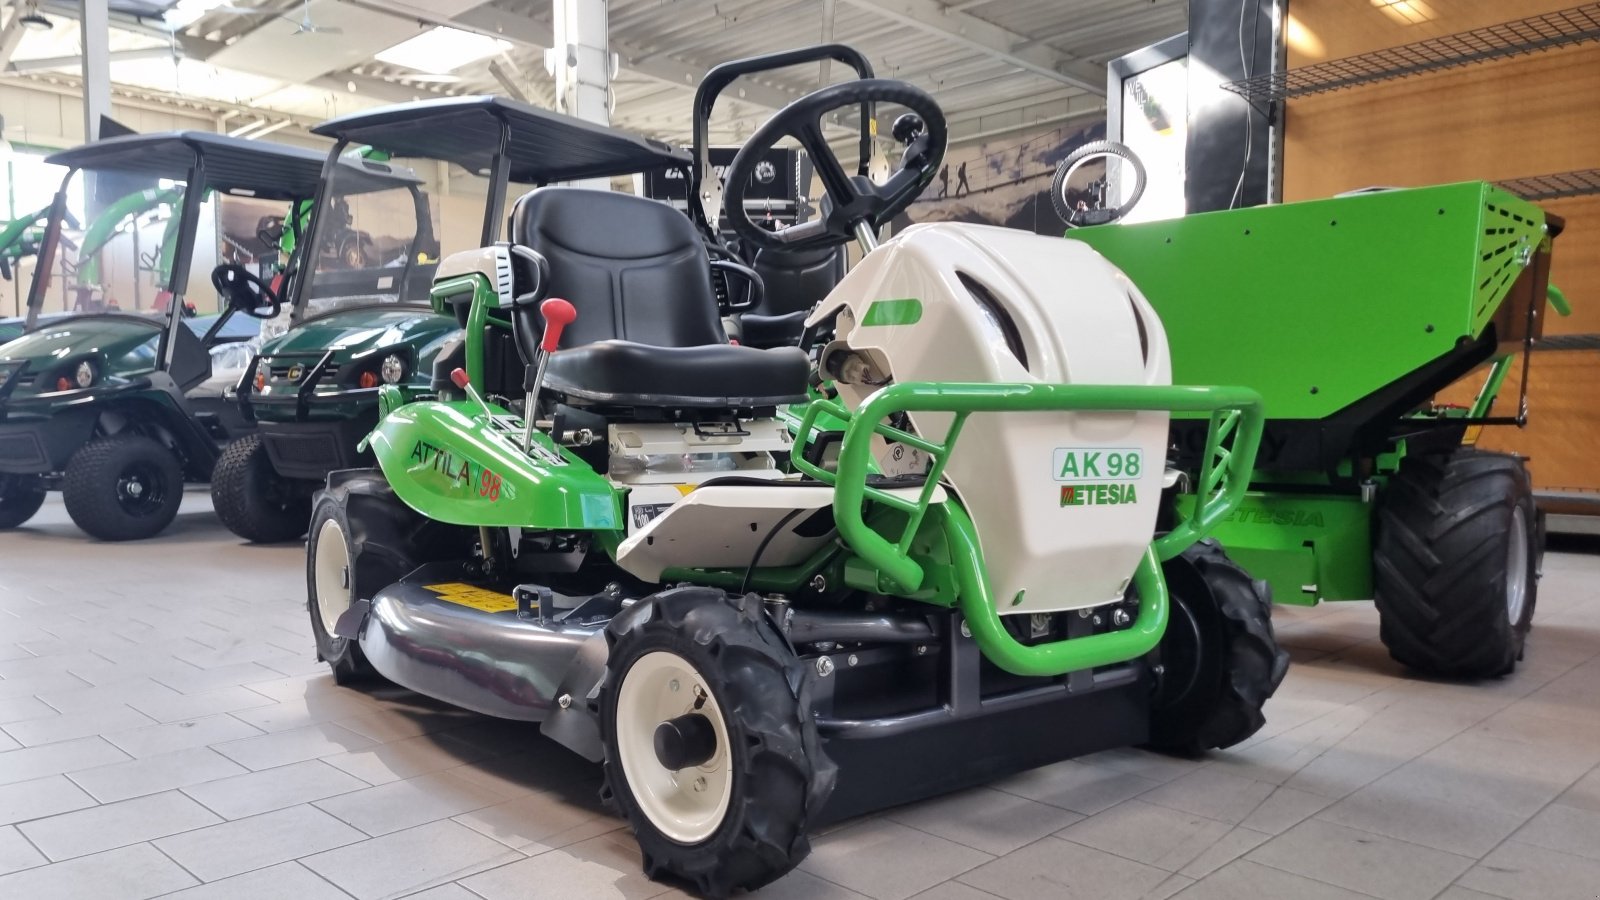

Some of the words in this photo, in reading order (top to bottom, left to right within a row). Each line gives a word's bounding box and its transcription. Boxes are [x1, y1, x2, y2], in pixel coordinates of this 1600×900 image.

[411, 440, 469, 486] ATTILA
[480, 469, 502, 502] 98
[1060, 452, 1101, 477] AK
[1107, 453, 1140, 476] 98
